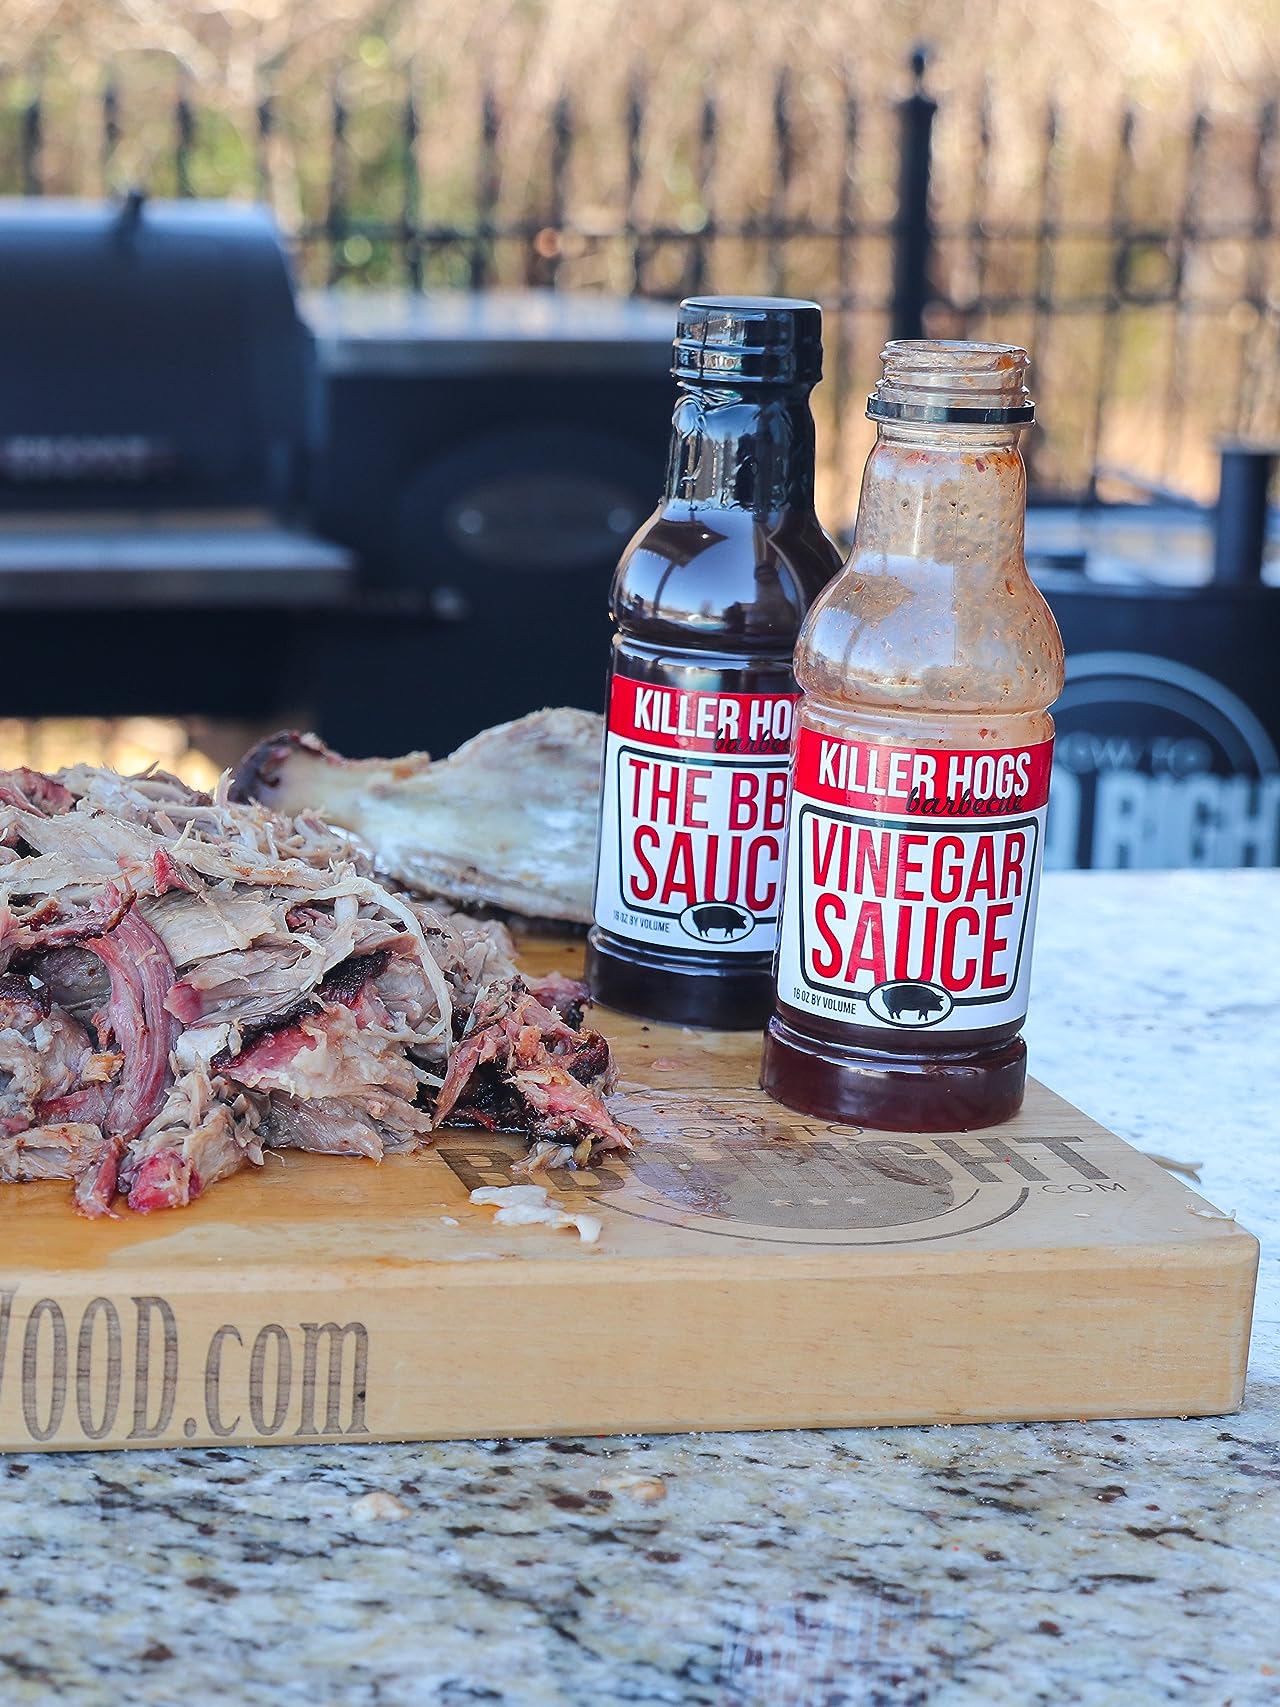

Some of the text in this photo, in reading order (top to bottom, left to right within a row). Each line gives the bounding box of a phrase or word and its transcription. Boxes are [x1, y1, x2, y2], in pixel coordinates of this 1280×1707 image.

[633, 686, 794, 742] KILLER HO
[712, 727, 791, 754] barbe
[819, 741, 1031, 800] KILLER HOGS
[627, 757, 789, 831] THE BB
[905, 786, 1024, 816] barbecue
[629, 824, 780, 912] SAUC
[811, 817, 1027, 903] VINEGAR
[640, 918, 670, 934] VOLUME
[811, 892, 1014, 993] SAUCE
[793, 987, 857, 1015] 16 OZ BY VOLUME
[789, 1124, 865, 1138] TO
[1036, 1181, 1127, 1195] .COM
